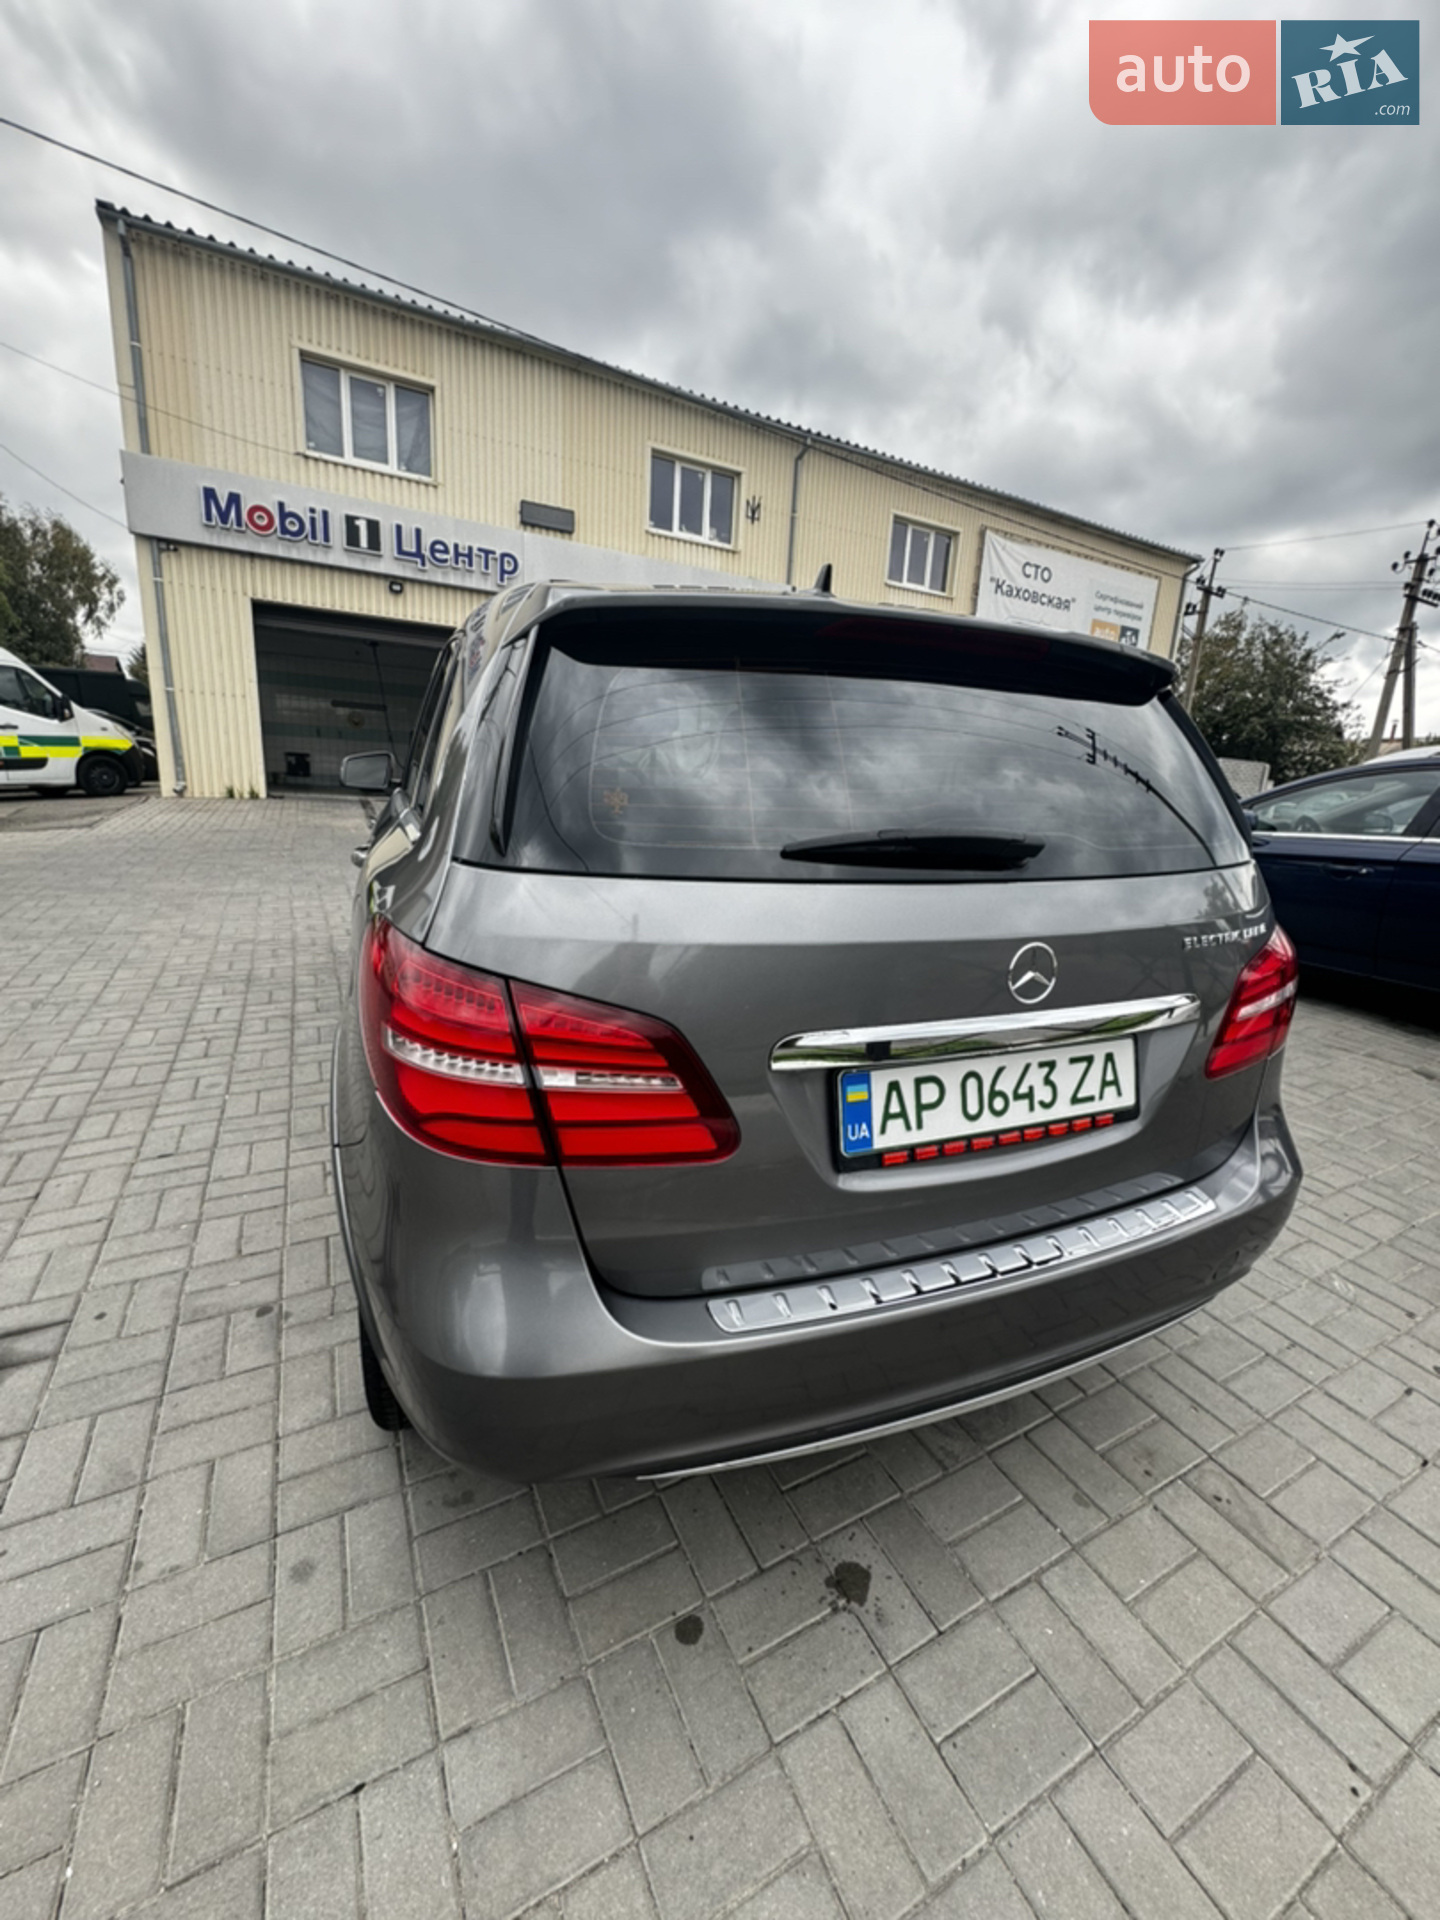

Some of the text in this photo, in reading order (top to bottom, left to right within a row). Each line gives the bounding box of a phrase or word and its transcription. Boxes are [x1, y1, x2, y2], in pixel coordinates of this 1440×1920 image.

[202, 485, 332, 547] Mobil
[394, 522, 520, 584] Центр
[1021, 561, 1053, 584] СТО
[989, 576, 1077, 612] "Каховская"
[880, 1051, 1122, 1135] AP 0643 ZA
[847, 1121, 870, 1140] UA
